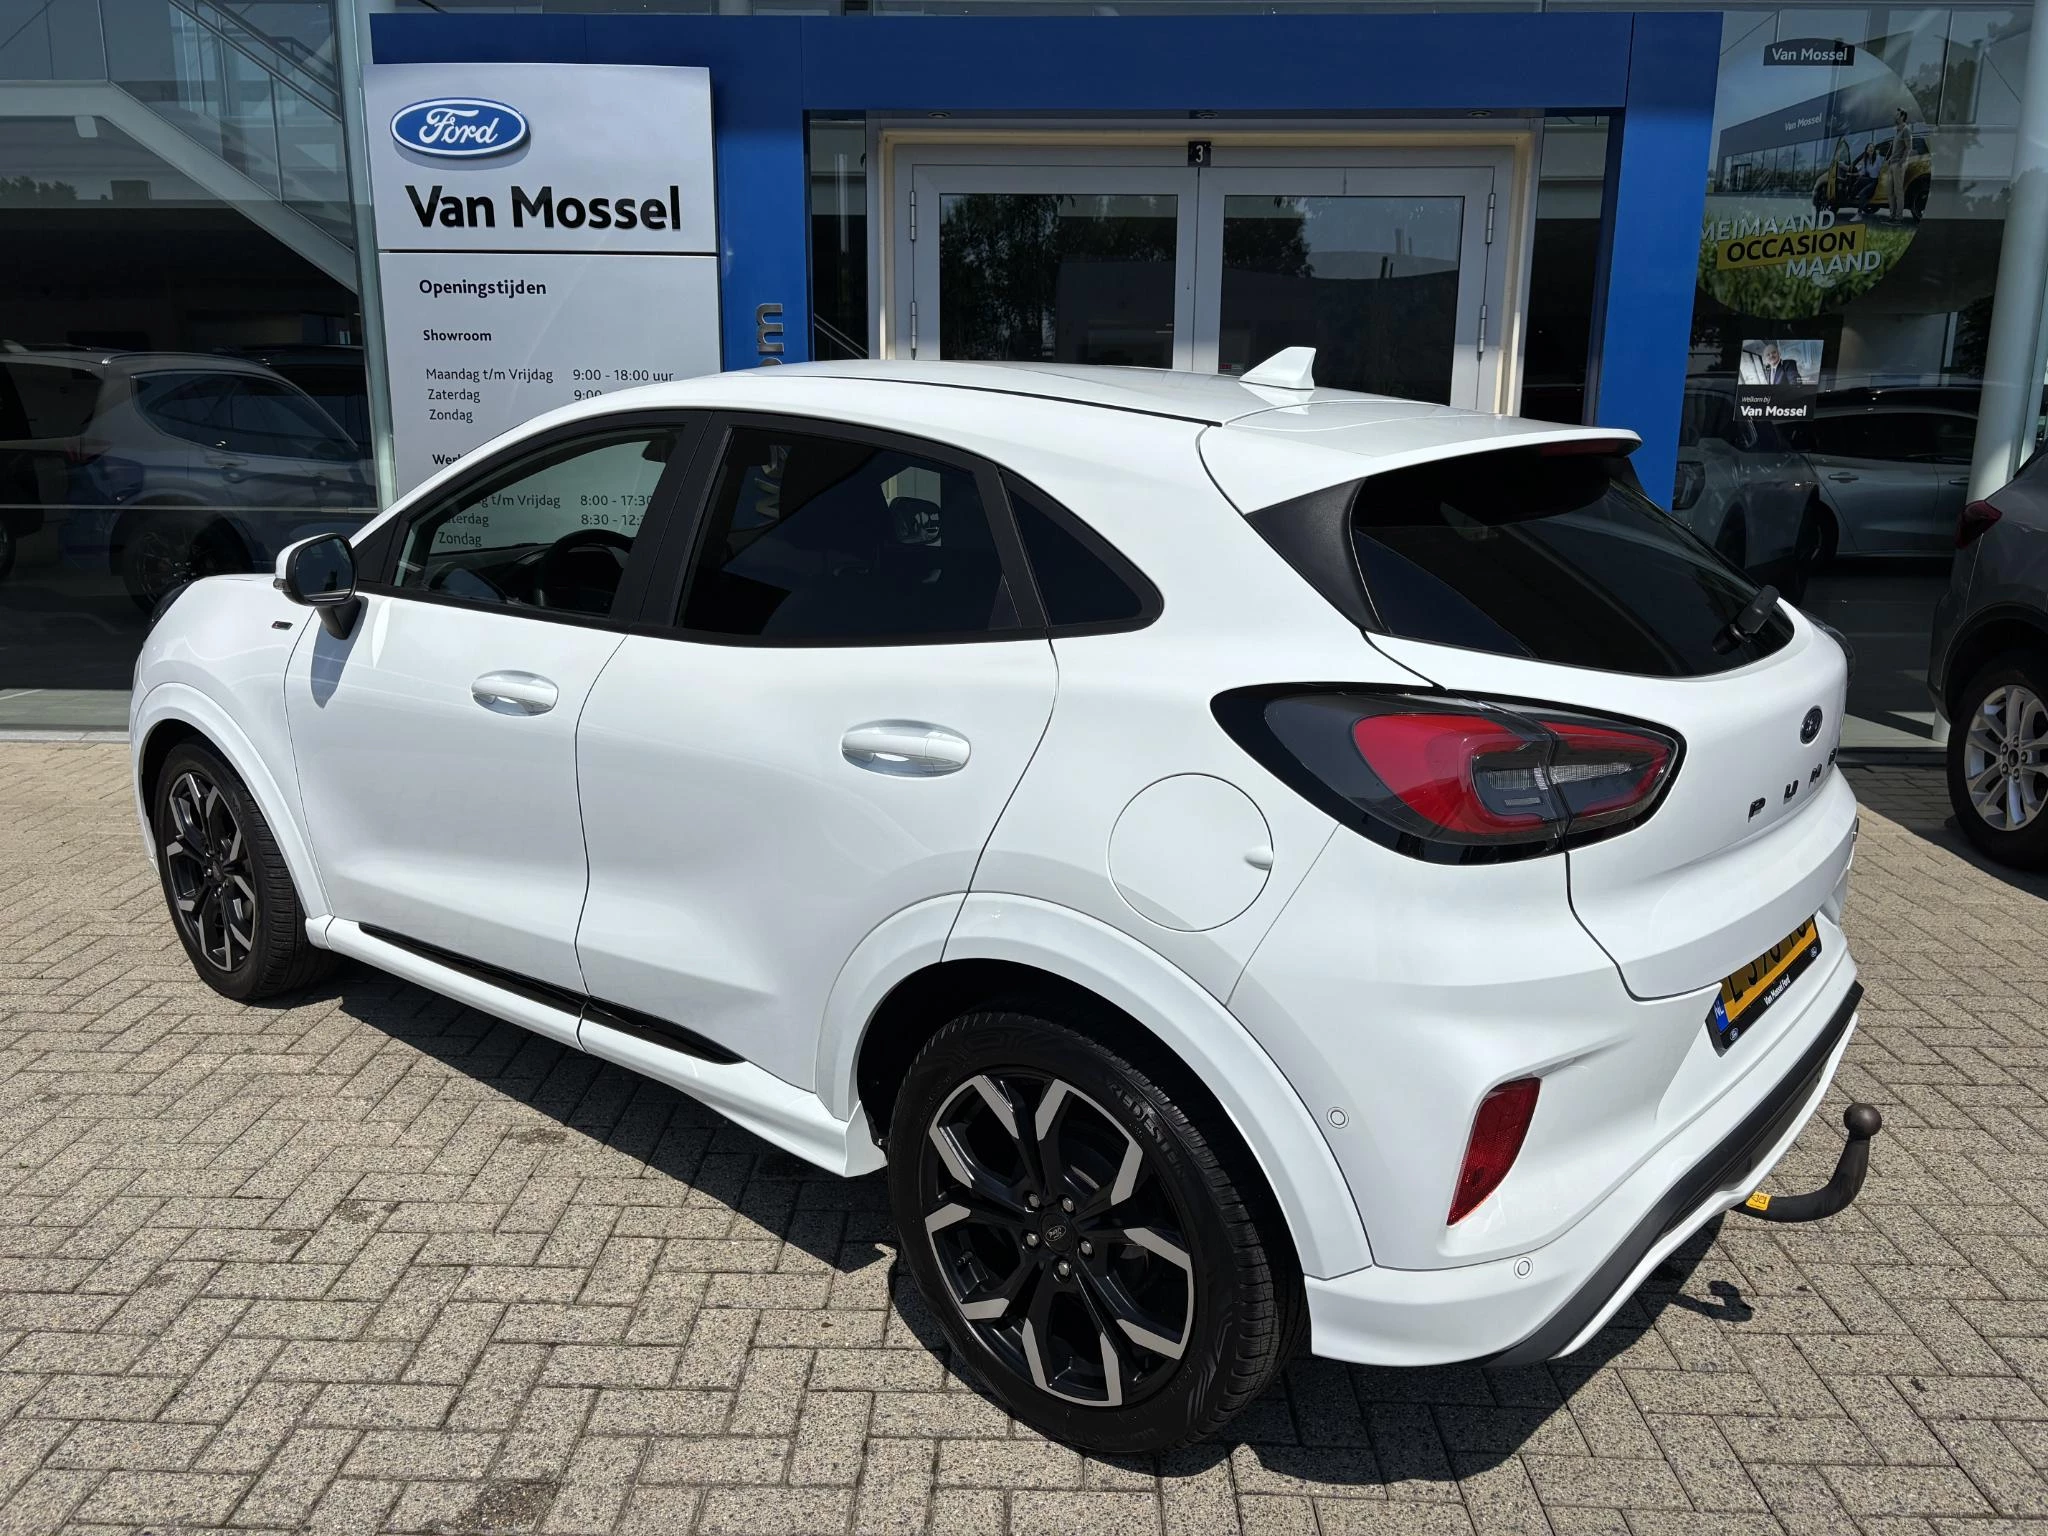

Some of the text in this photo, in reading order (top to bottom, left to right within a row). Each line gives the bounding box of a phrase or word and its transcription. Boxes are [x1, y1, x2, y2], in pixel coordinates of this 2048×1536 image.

[1771, 47, 1848, 61] Van Mossel
[418, 107, 499, 145] Ford
[1195, 144, 1204, 163] 3
[404, 184, 682, 232] Van Mossel
[1726, 230, 1857, 264] OCCASION
[1785, 250, 1882, 280] MAAND
[418, 279, 547, 299] Openingstijden
[422, 329, 492, 342] Showroom
[425, 367, 480, 384] Maandag
[482, 367, 507, 382] t/m
[509, 368, 554, 384] Vrijdag
[572, 369, 602, 381] 9:00
[613, 369, 650, 382] 18:00
[652, 371, 675, 382] uur
[427, 388, 481, 403] Zaterdag
[428, 408, 474, 424] Zondag
[1740, 404, 1808, 417] Van Mossel
[491, 493, 514, 506] t/m
[516, 494, 561, 509] Vrijdag
[580, 494, 609, 507] 8:00
[581, 513, 610, 526] 8:30
[437, 531, 482, 548] Zondag
